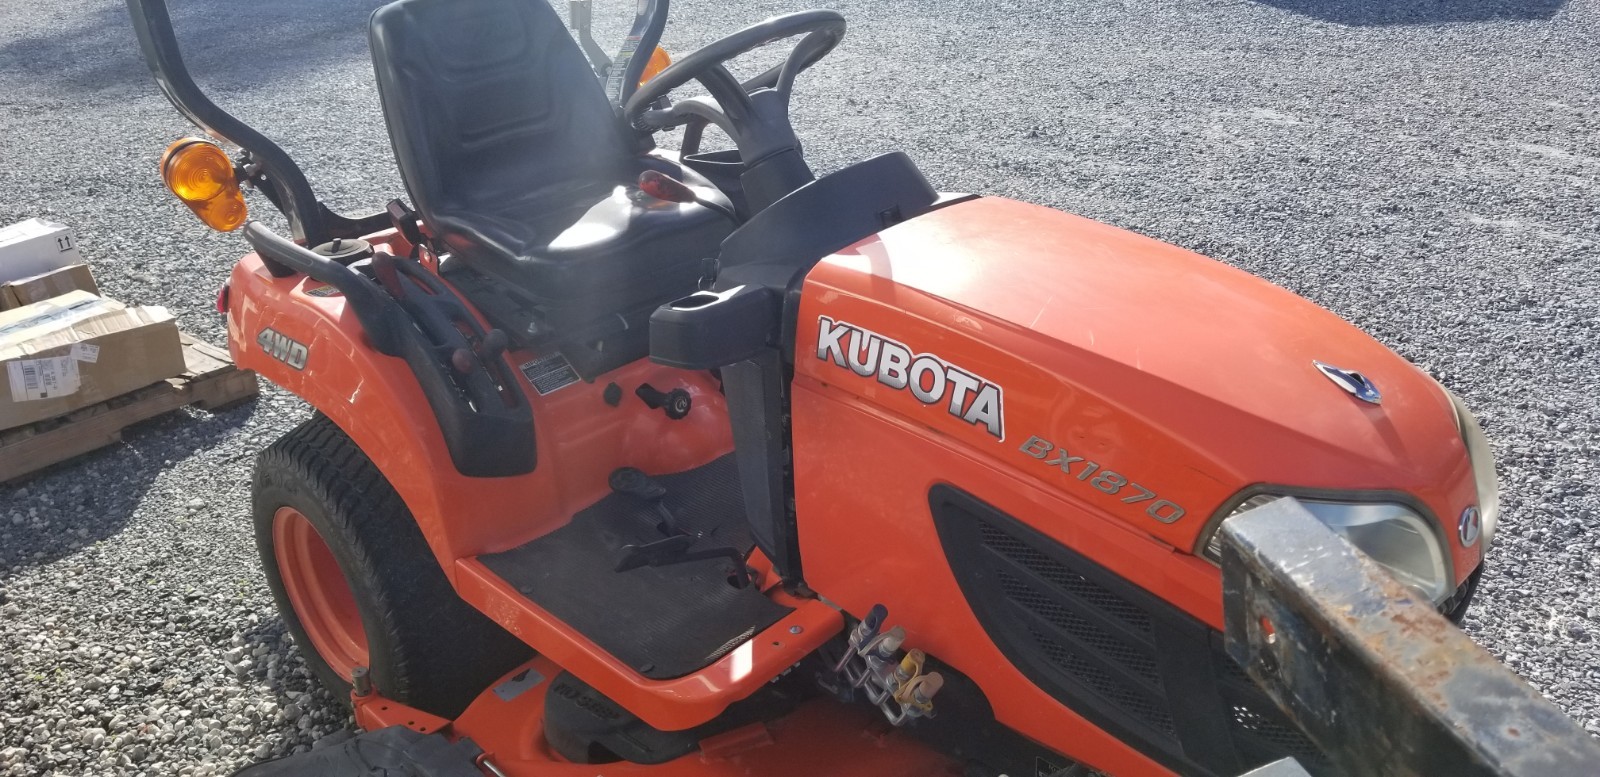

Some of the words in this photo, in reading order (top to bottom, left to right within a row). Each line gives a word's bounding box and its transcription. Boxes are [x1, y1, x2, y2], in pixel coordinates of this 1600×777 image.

[257, 327, 308, 370] 4WD
[817, 316, 1004, 439] KUBOTA
[1018, 434, 1187, 525] BX1870
